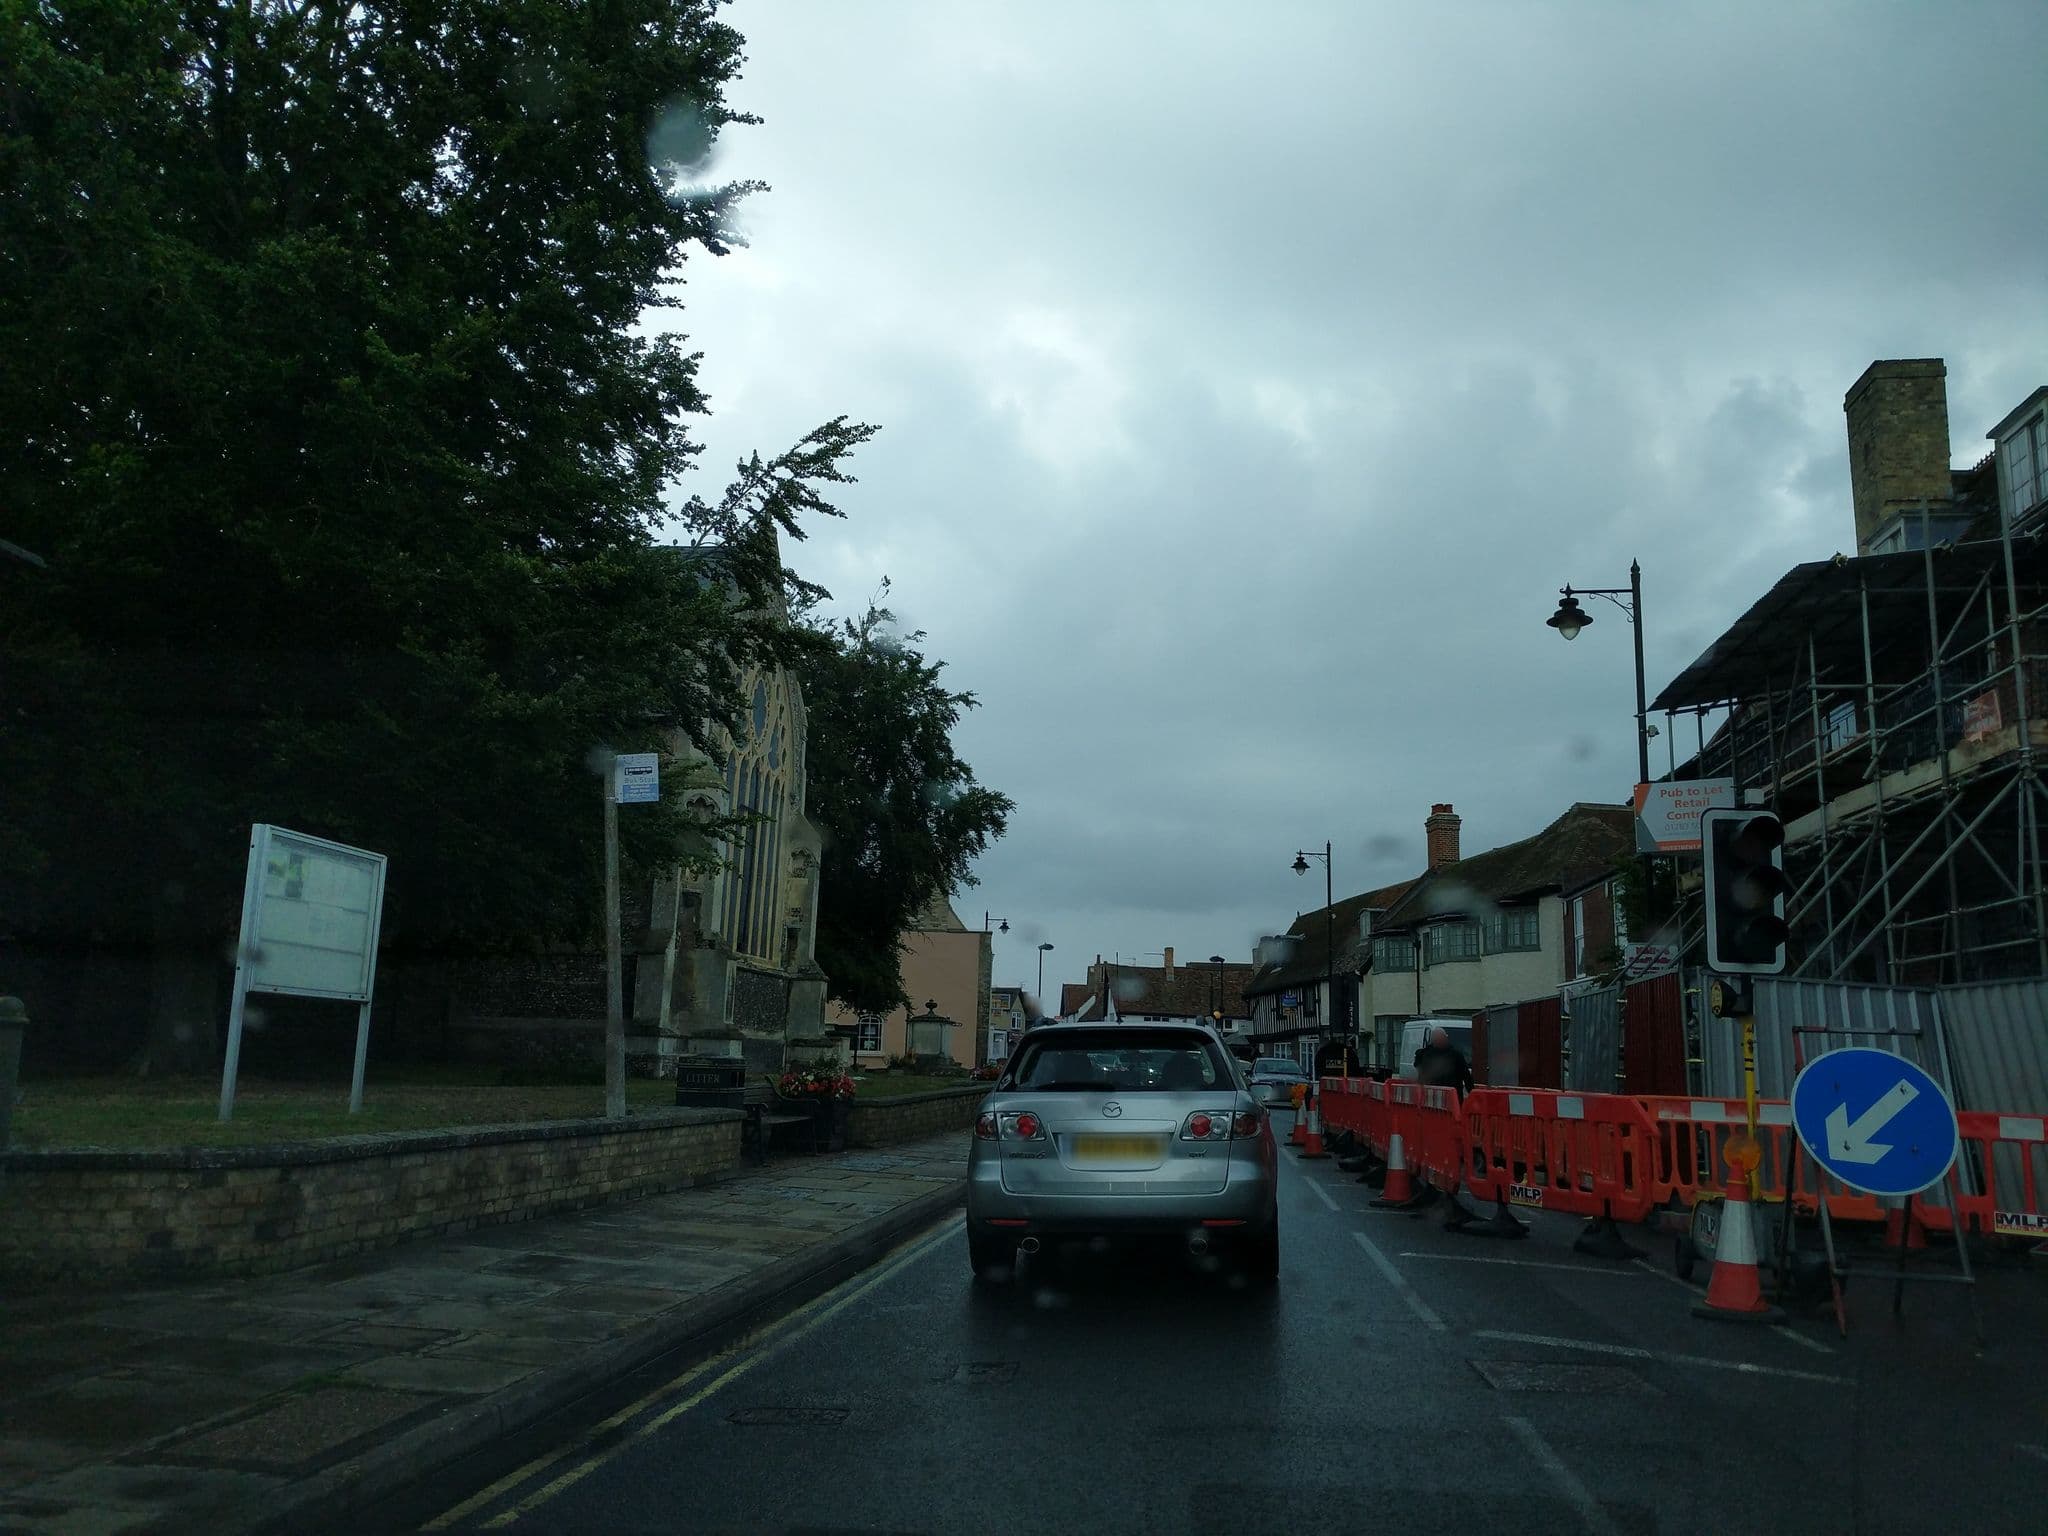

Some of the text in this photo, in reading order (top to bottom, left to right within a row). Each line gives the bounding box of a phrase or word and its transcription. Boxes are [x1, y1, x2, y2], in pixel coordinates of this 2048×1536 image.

[1660, 786, 1723, 798] Pub to Let
[1674, 798, 1710, 808] Retail
[1510, 1186, 1541, 1199] MLP
